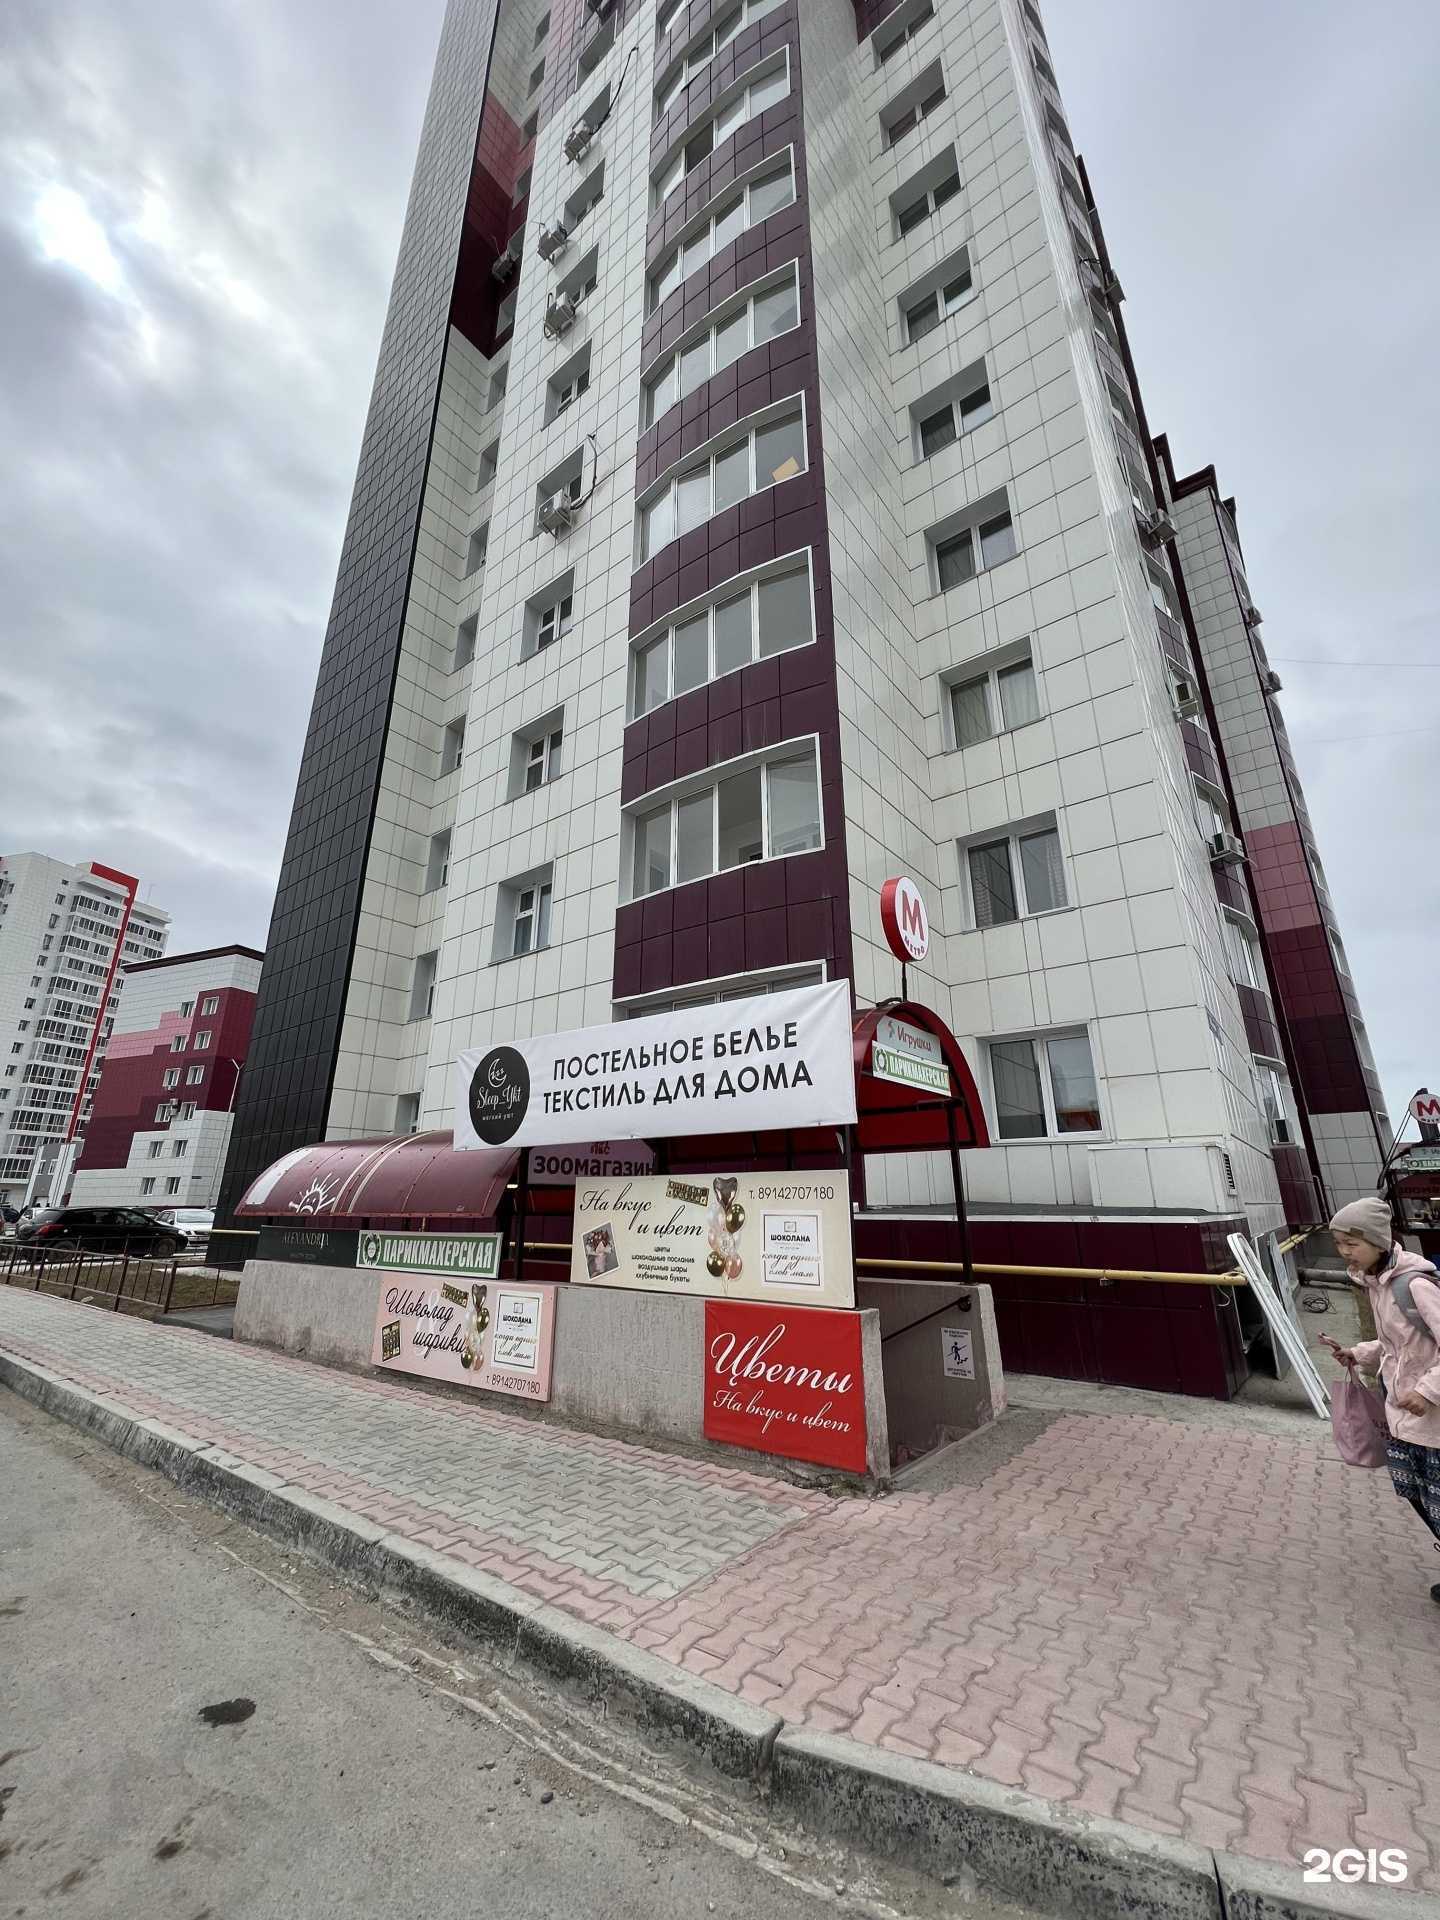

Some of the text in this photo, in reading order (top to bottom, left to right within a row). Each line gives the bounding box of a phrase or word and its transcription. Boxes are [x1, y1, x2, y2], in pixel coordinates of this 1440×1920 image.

[553, 1021, 798, 1081] ПОСТЕЛЬНОЕ БЕЛЬЕ
[897, 1025, 932, 1052] Игрушки
[543, 1060, 814, 1114] ТЕКСТИЛЬ ДЛЯ ДОМА
[580, 1190, 610, 1212] На
[612, 1182, 652, 1231] вкус
[758, 1186, 835, 1201] 89142707180
[637, 1204, 704, 1239] и цвет
[770, 1234, 811, 1243] ШОКОЛАНА
[383, 1239, 494, 1269] ПАРИКМАХЕРСКАЯ
[385, 1287, 455, 1332] Шоколад
[412, 1323, 467, 1360] шарики
[710, 1323, 854, 1394] Цветы
[492, 1373, 542, 1395] 89142707180
[713, 1389, 852, 1435] На вкус и цвет
